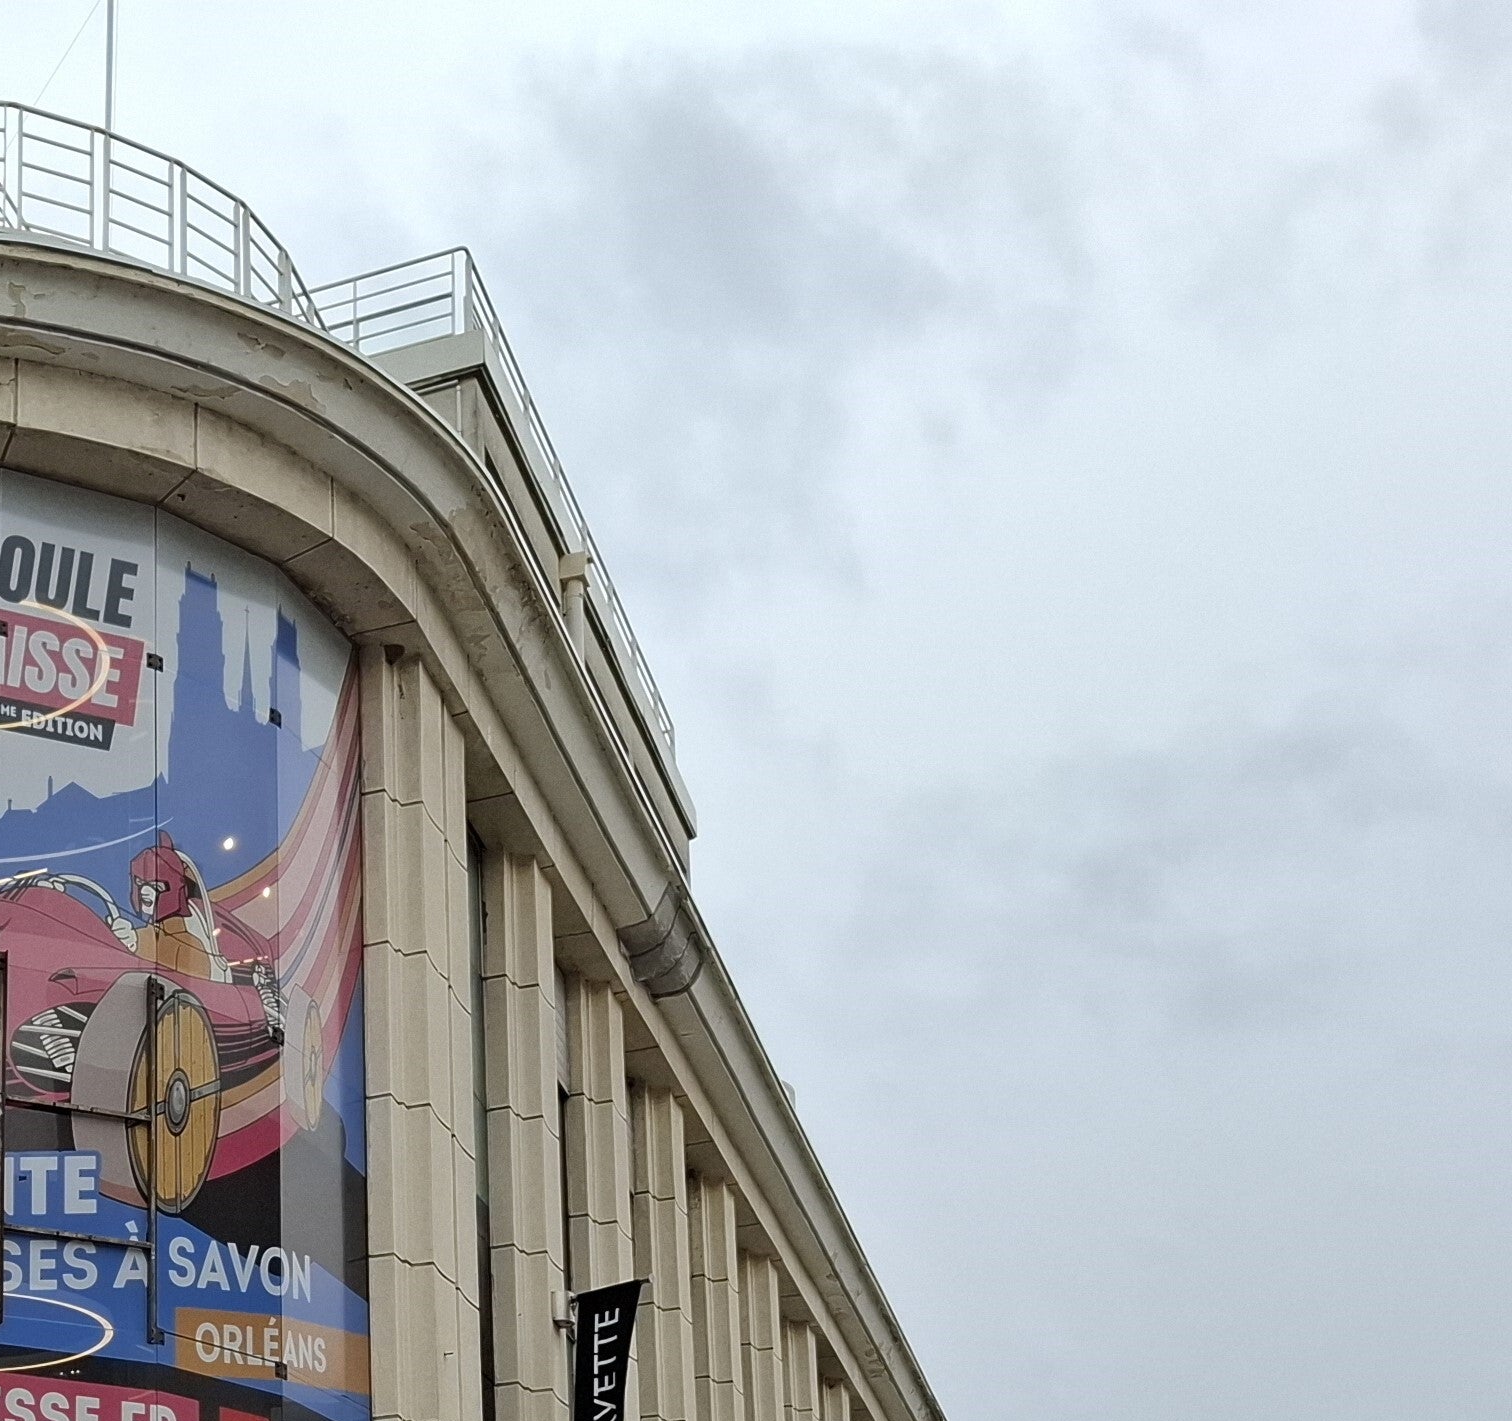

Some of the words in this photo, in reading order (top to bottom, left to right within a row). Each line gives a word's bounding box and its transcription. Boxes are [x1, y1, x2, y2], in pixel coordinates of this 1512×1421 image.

[22, 709, 103, 743] EDITION
[113, 1221, 149, 1289] À
[168, 1235, 312, 1303] SAVON
[194, 1317, 328, 1374] ORLÉANS
